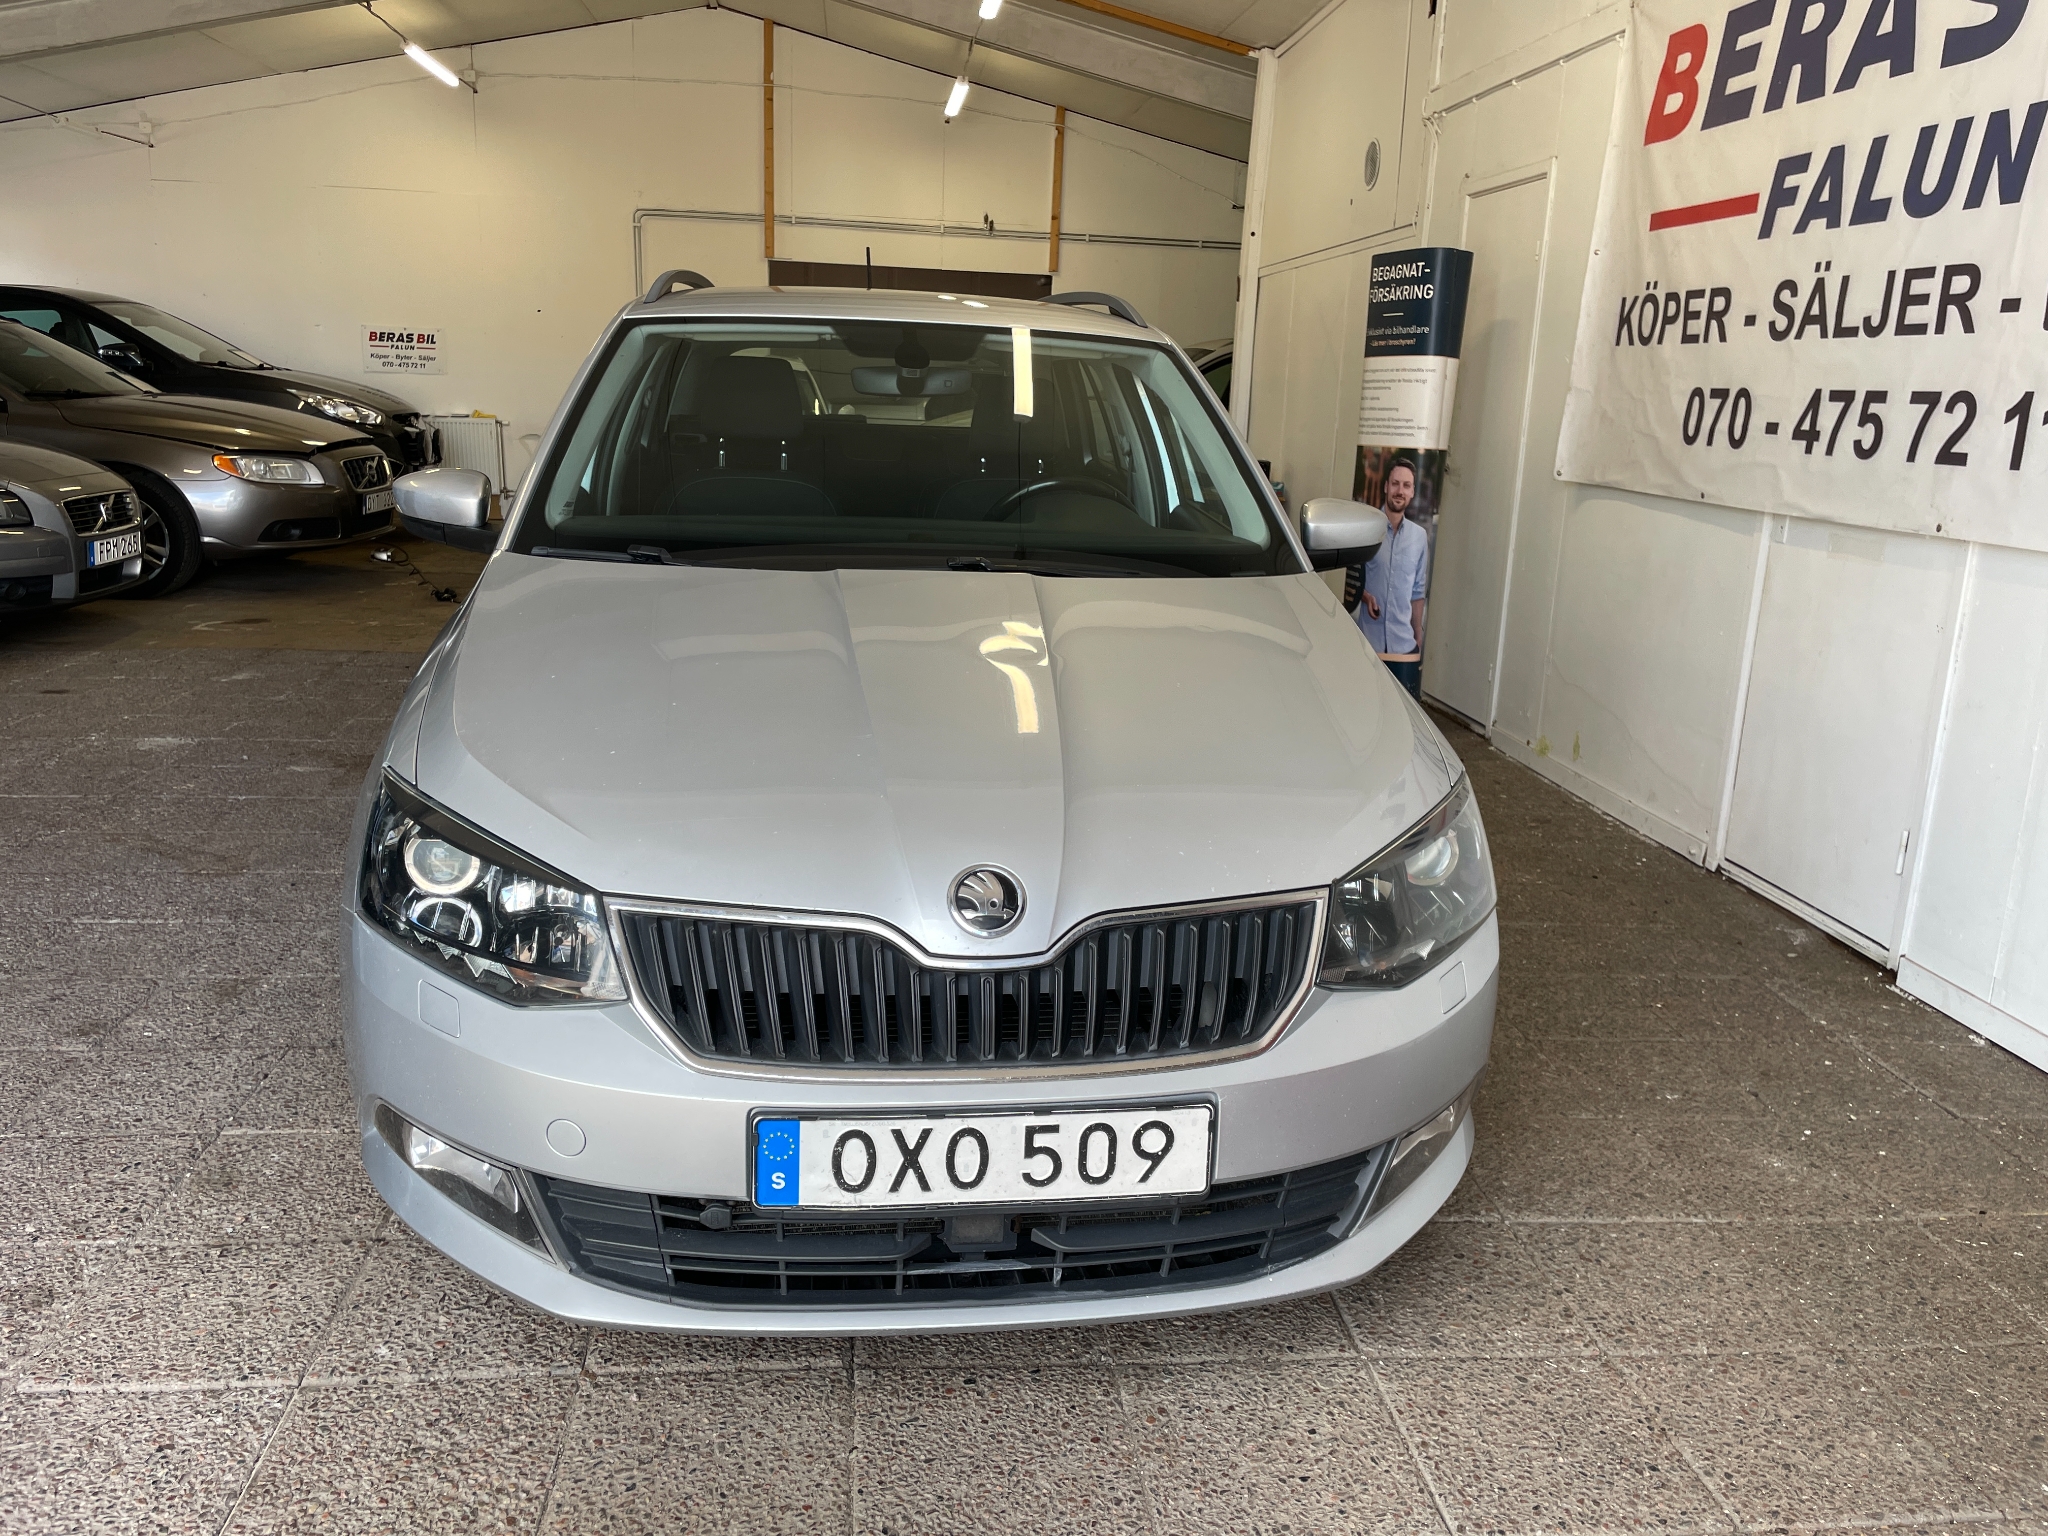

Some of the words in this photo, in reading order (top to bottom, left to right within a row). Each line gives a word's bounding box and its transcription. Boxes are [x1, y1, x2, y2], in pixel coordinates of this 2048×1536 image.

[1643, 0, 2030, 147] BERAS
[1757, 100, 2048, 240] FALUN
[1369, 284, 1435, 304] FÖRSÄKRING
[1372, 262, 1431, 282] BEGAGNAT-
[1615, 281, 1732, 347] KÖPER
[1768, 261, 1982, 342] SÄLJER
[369, 331, 414, 343] BERAS
[417, 333, 436, 345] BIL
[370, 352, 390, 360] Köper
[418, 354, 436, 363] Säljer
[1682, 387, 1752, 450] 070
[1792, 388, 1889, 461] 475
[1906, 390, 1977, 467] 72
[2003, 391, 2048, 472] 1
[99, 538, 119, 562] FPM
[120, 534, 138, 556] 265
[771, 1172, 786, 1191] S
[831, 1127, 990, 1194] OXO
[1020, 1119, 1176, 1188] 509
